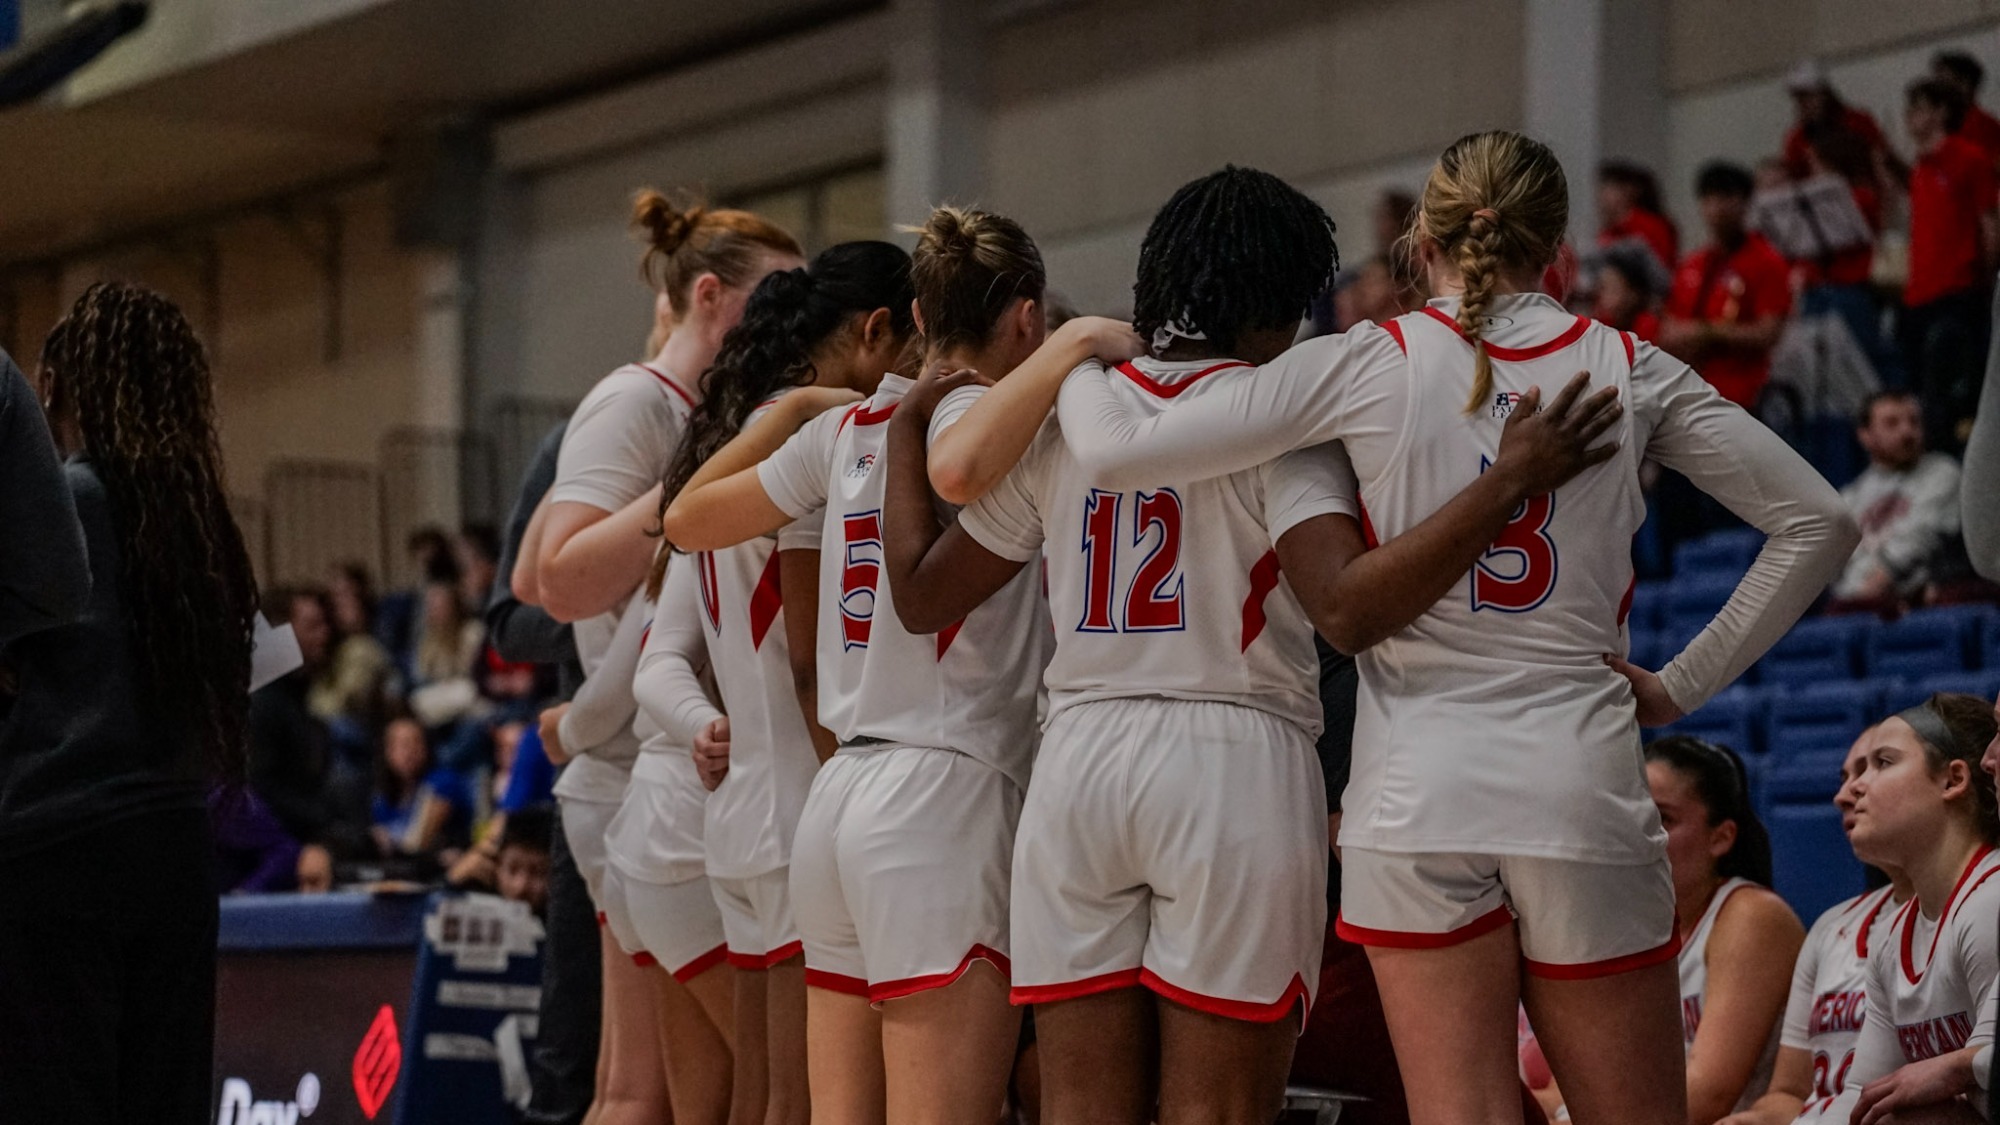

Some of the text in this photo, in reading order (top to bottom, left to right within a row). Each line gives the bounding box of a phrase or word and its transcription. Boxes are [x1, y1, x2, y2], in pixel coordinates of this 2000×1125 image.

[839, 509, 883, 653] 5
[1076, 488, 1186, 633] 12
[1471, 453, 1558, 612] 3
